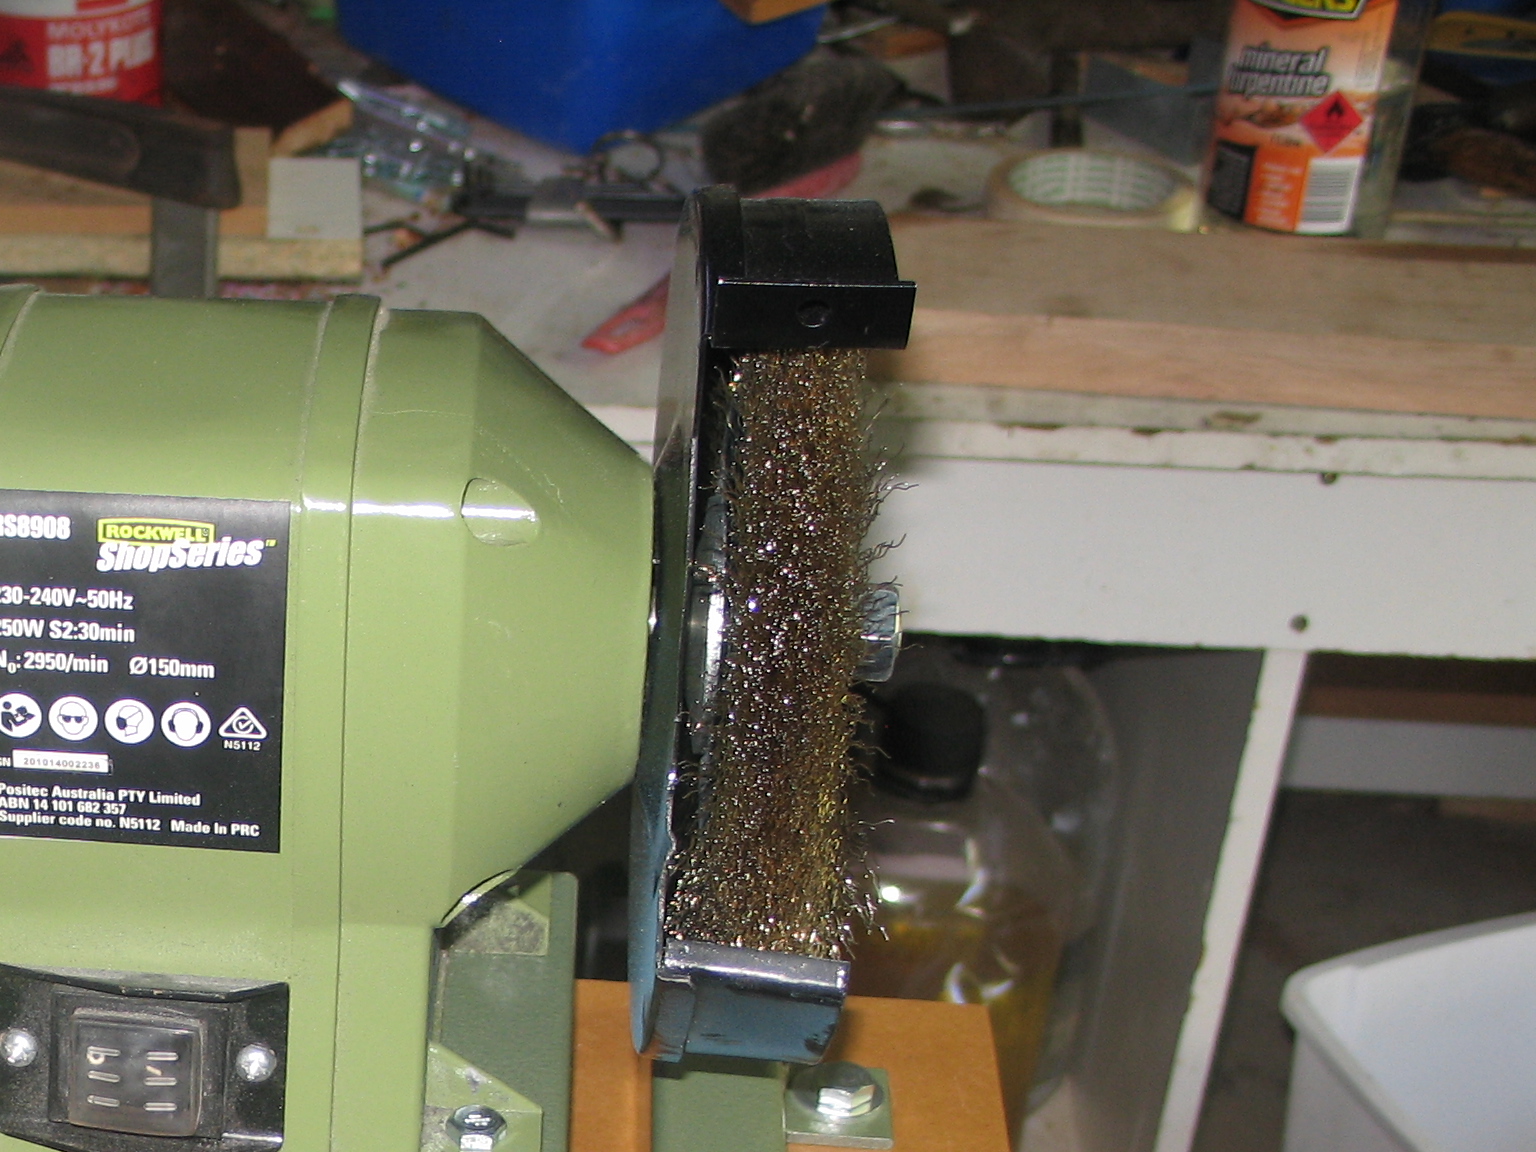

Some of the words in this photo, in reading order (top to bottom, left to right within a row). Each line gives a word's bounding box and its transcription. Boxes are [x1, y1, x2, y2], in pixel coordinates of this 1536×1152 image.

[106, 524, 206, 542] ROCKWELL
[96, 537, 264, 572] ShopSeries
[49, 620, 135, 643] S2:30min
[128, 656, 215, 679] Ø150mm
[224, 740, 261, 751] N5112
[51, 785, 114, 801] Australia
[118, 789, 146, 803] PTY
[148, 791, 201, 806] Limited
[33, 798, 49, 811] 14
[52, 800, 73, 812] 101
[77, 801, 101, 814] 682
[103, 802, 127, 815] 357
[58, 814, 92, 827] code
[95, 817, 116, 828] no.
[119, 816, 161, 831] N5112
[170, 819, 211, 835] Made
[230, 823, 261, 837] PRC
